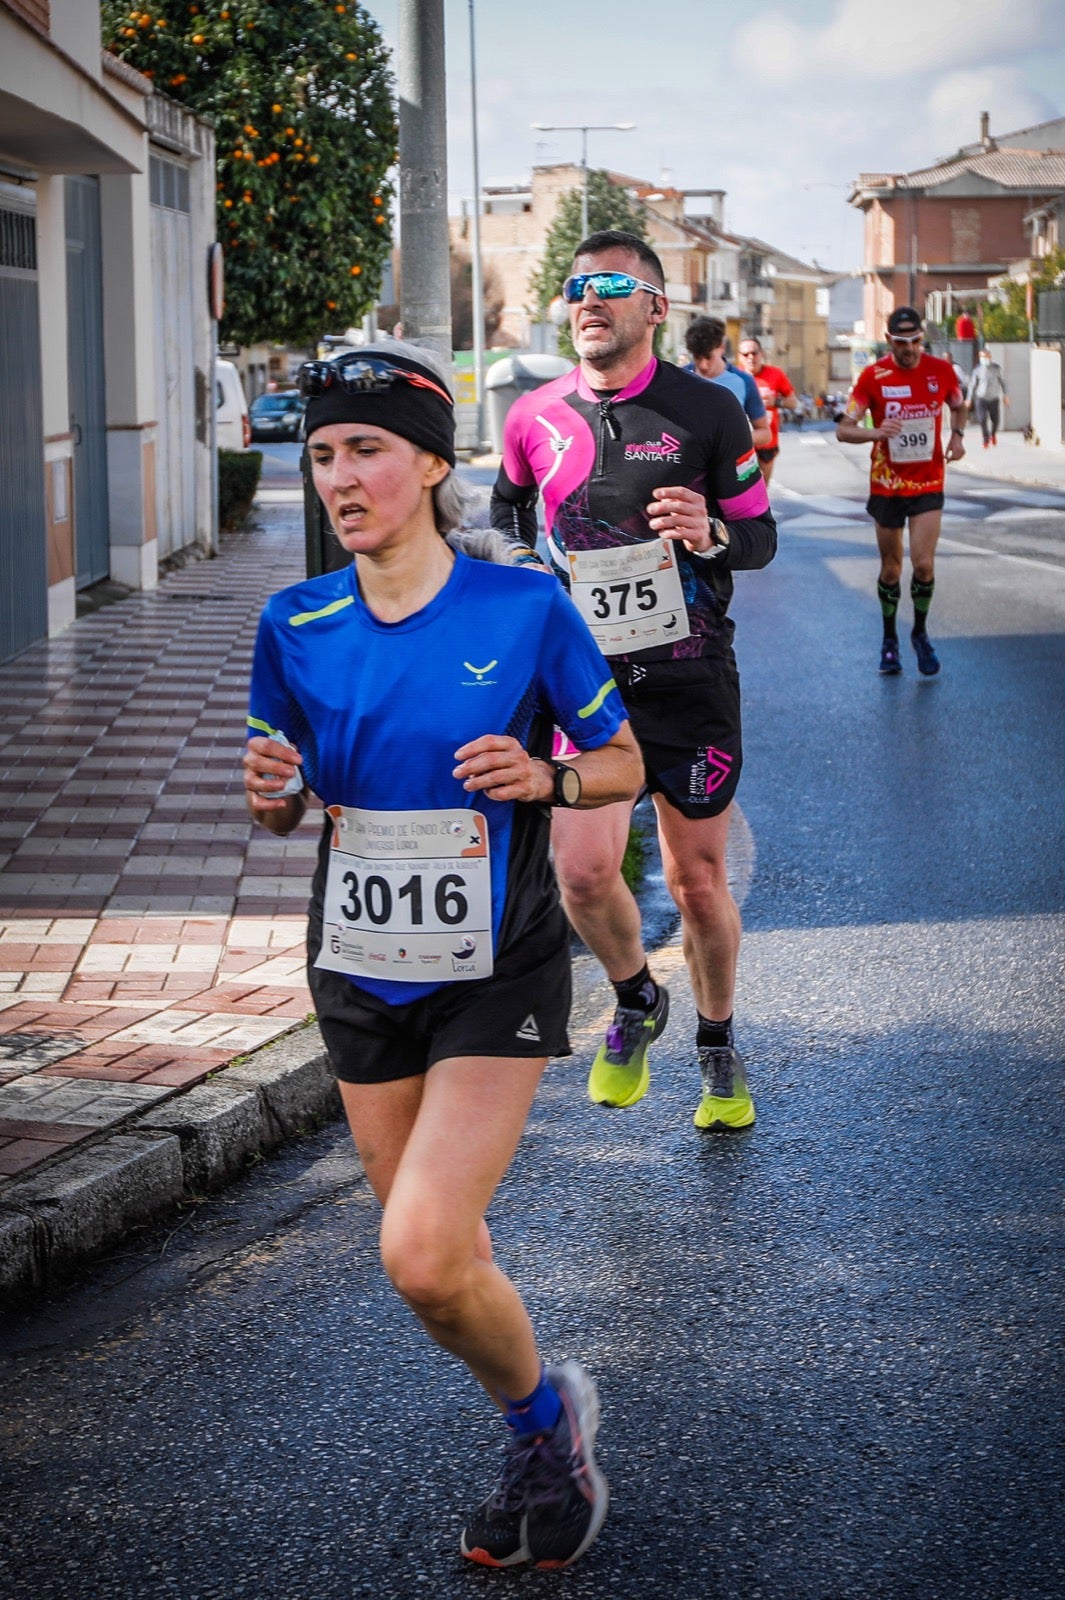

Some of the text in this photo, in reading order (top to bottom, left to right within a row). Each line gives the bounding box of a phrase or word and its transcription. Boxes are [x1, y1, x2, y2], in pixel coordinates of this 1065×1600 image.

[623, 450, 682, 464] SANTA FE
[899, 432, 928, 448] 399
[590, 578, 658, 619] 375
[696, 759, 707, 795] SANTA
[340, 871, 468, 925] 3016
